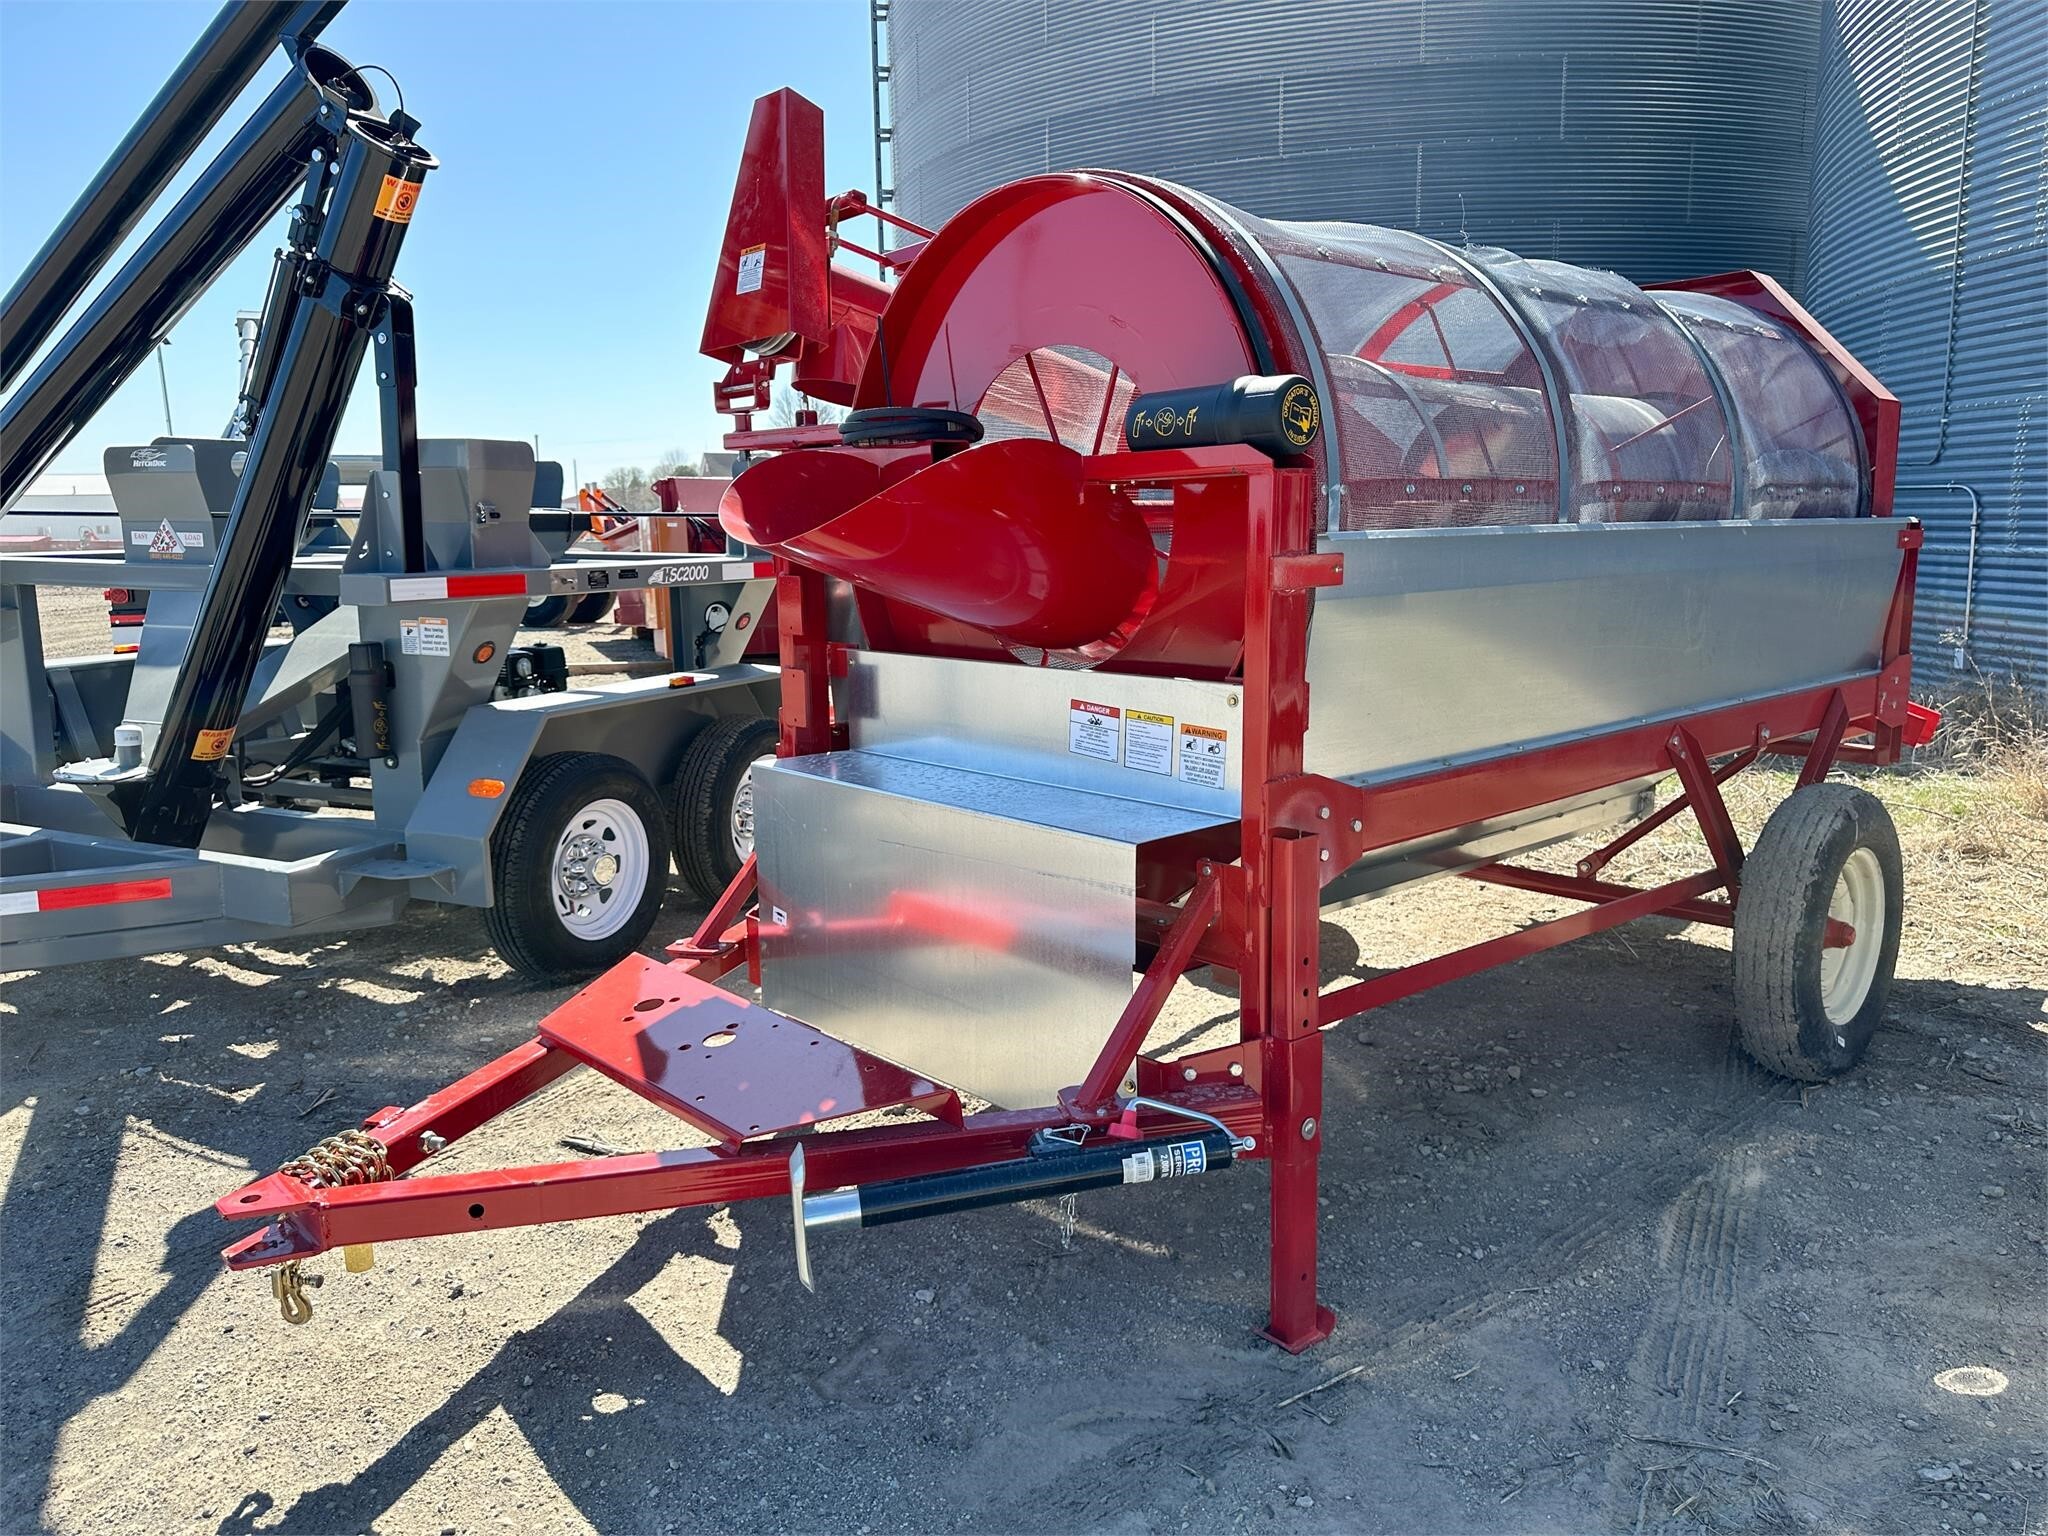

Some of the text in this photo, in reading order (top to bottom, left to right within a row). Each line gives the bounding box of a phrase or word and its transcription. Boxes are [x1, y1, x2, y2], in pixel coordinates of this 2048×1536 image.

[1309, 396, 1318, 427] MANUAL
[1288, 429, 1307, 442] INSIDE
[1086, 704, 1110, 715] DANGER
[1143, 714, 1164, 723] CAUTION
[1191, 727, 1223, 740] WARNING
[1185, 1147, 1201, 1175] PRO
